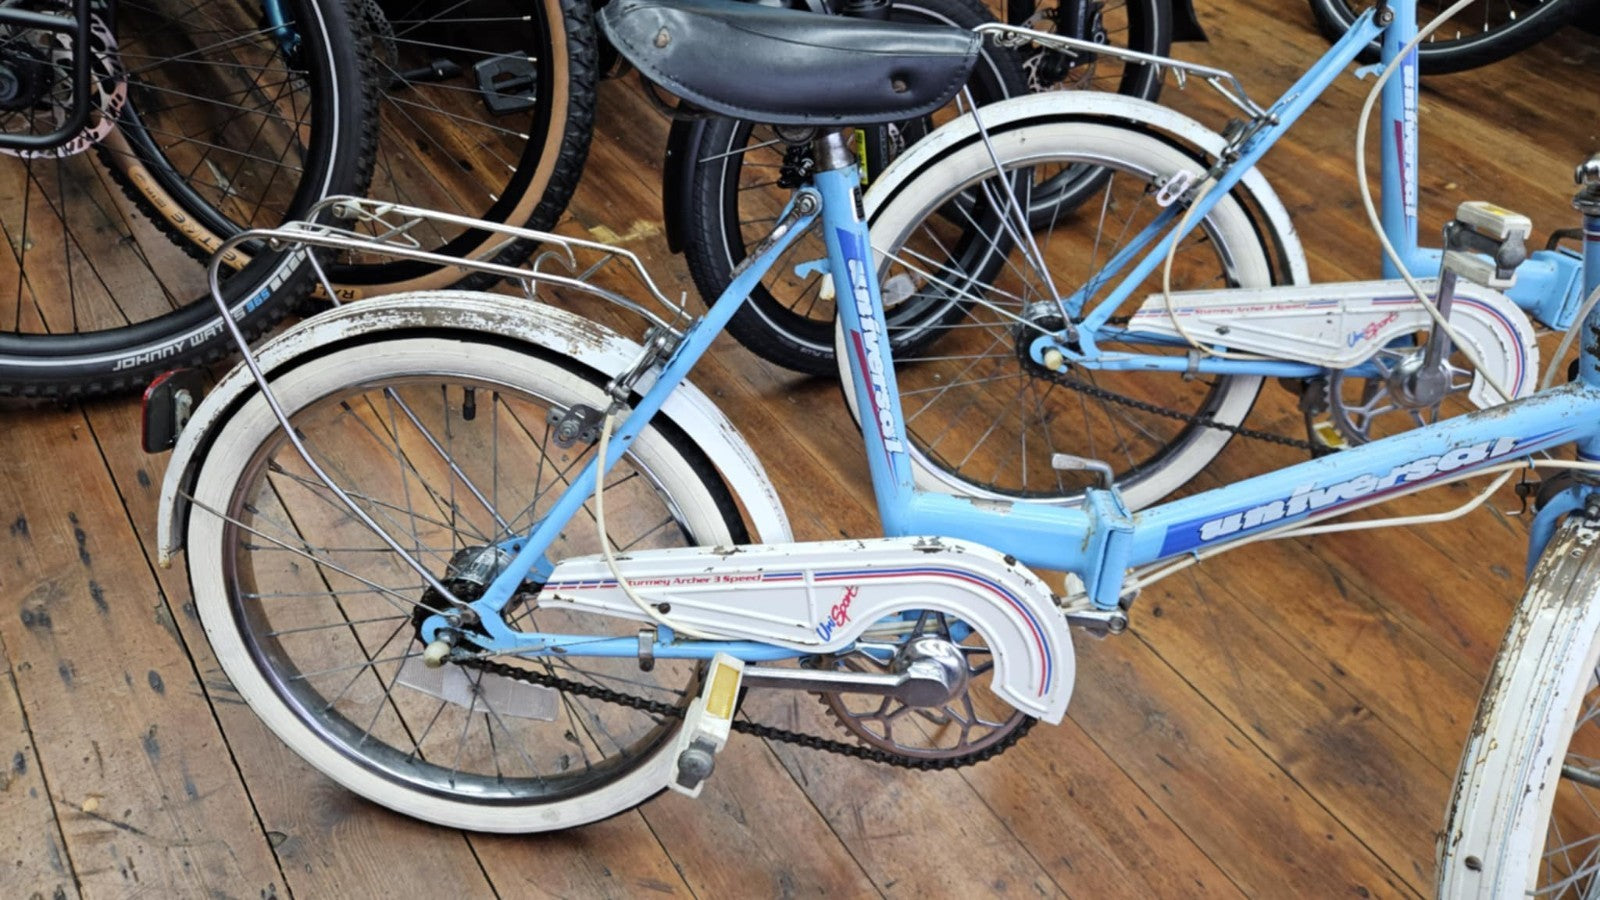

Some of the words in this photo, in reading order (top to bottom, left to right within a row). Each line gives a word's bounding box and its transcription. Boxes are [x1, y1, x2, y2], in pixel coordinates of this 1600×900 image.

[112, 341, 185, 371] JOHNNY
[190, 307, 246, 347] WATS
[848, 258, 904, 454] universal
[1199, 437, 1519, 541] universal
[627, 579, 671, 587] turmey
[674, 576, 709, 585] Archer
[723, 574, 762, 583] Speed
